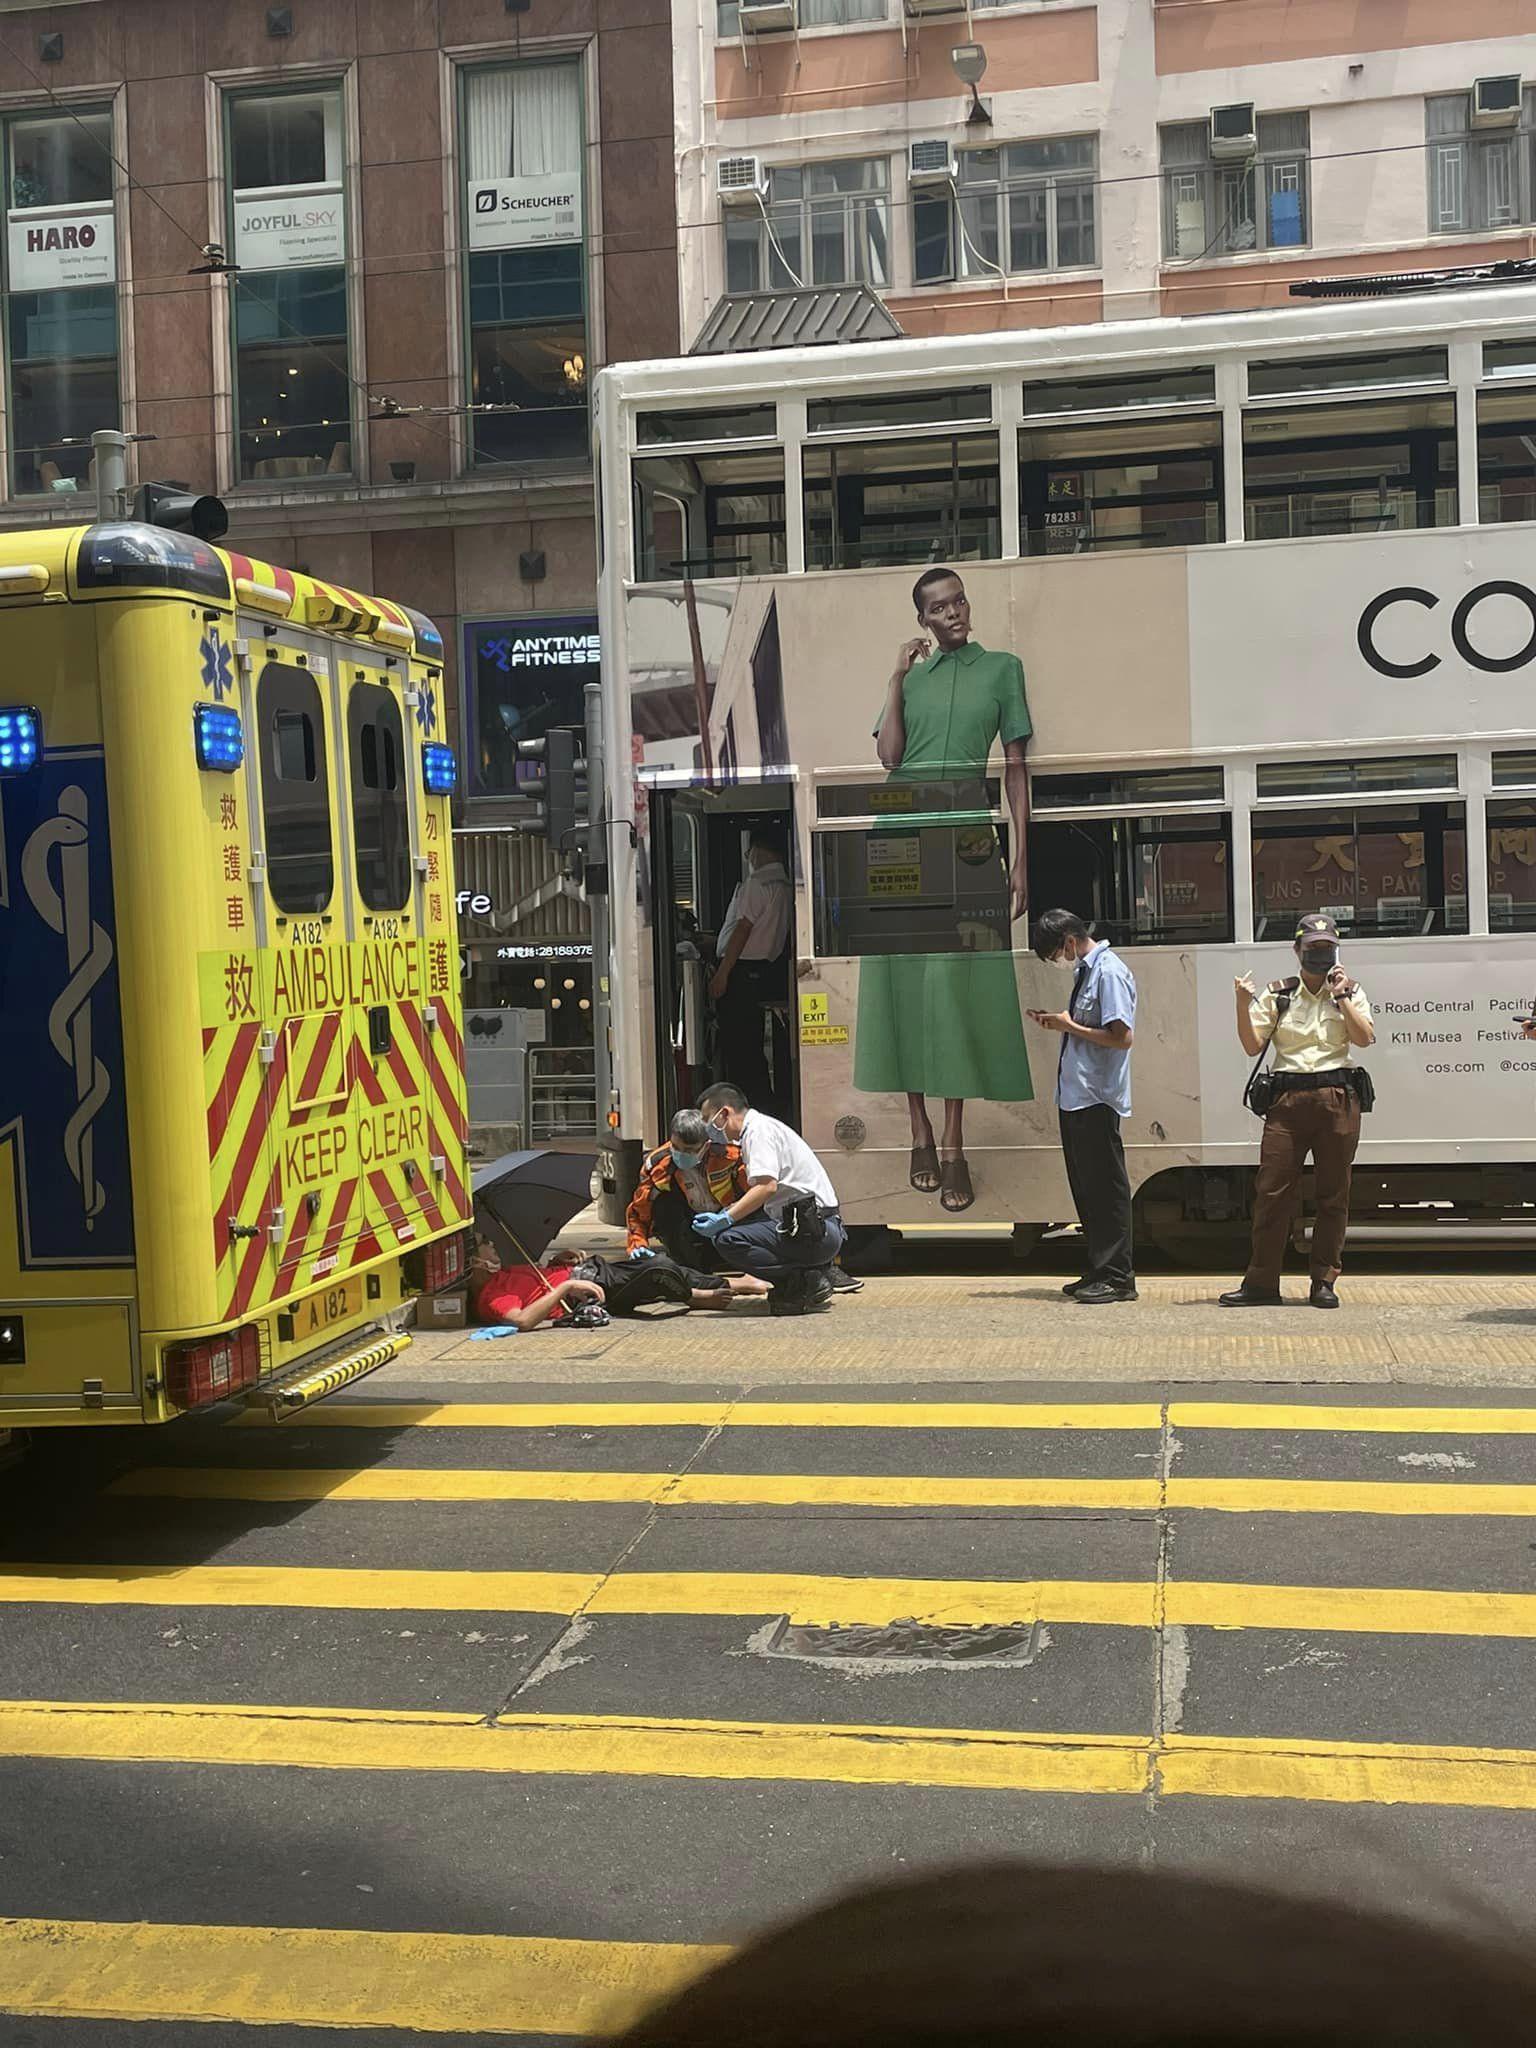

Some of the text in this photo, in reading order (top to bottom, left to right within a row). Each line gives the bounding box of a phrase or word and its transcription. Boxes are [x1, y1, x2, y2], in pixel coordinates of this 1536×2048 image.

[501, 195, 571, 210] SCHEUCHER
[242, 210, 337, 232] JOYFUL SKY
[27, 224, 96, 253] HARO
[1357, 580, 1536, 679] CO
[512, 635, 600, 652] ANYTIME
[512, 650, 600, 667] FITNESS
[220, 792, 245, 933] 救護車
[292, 922, 322, 946] A182
[373, 918, 399, 940] A182
[428, 938, 450, 992] 護
[224, 953, 256, 1022] 救
[273, 941, 420, 1016] AMBULANCE
[803, 1012, 826, 1022] EXIT
[1385, 1002, 1420, 1014] Road
[1424, 1000, 1474, 1013] Central
[1391, 1031, 1462, 1044] K11 Musea
[1477, 1029, 1530, 1042] Festiva
[1425, 1063, 1485, 1074] cos.com
[1500, 1059, 1536, 1072] @cos
[285, 1105, 424, 1189] KEEP CLEAR
[310, 1287, 348, 1330] A 182
